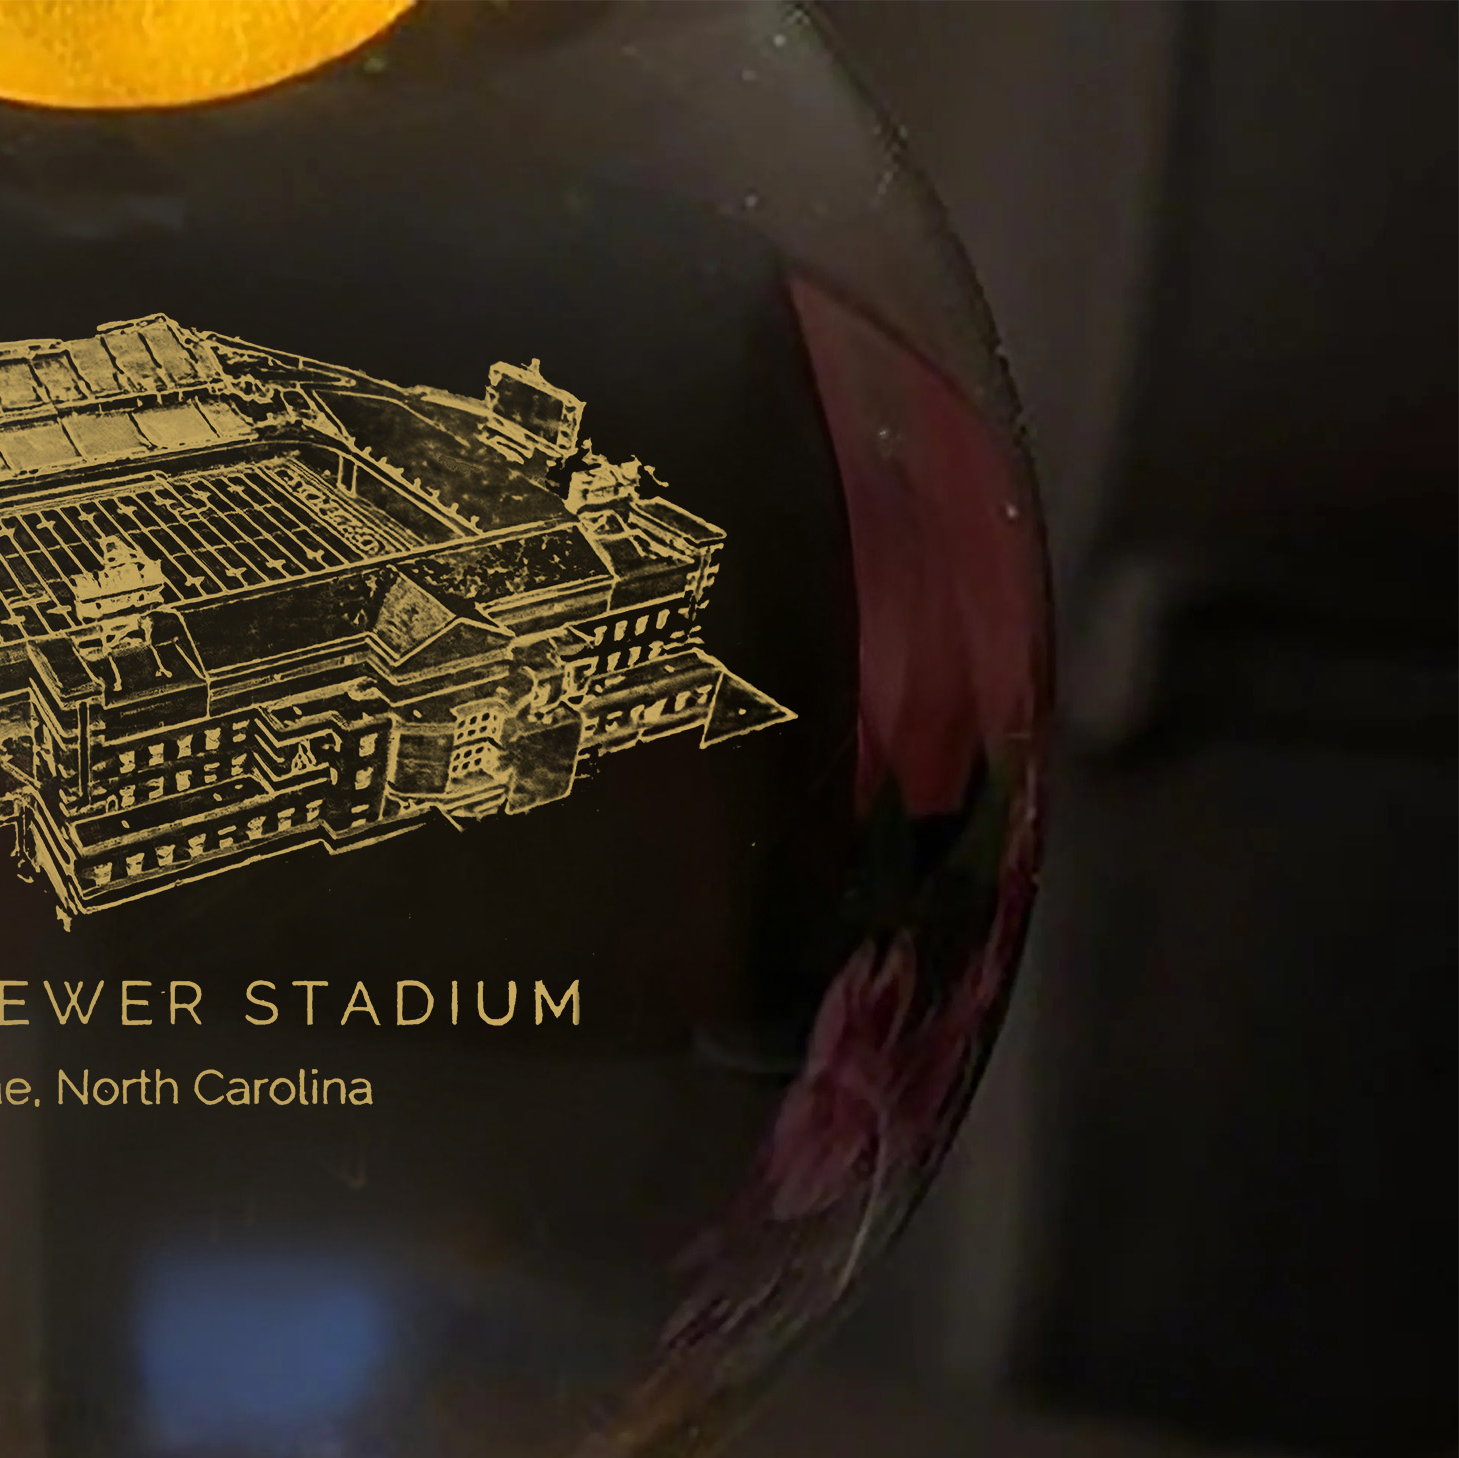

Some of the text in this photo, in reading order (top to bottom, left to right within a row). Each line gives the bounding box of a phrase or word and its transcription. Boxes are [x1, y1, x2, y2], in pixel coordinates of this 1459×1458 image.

[245, 979, 581, 1026] STADIUM
[58, 1068, 179, 1106] North
[193, 1068, 374, 1106] Carolina
